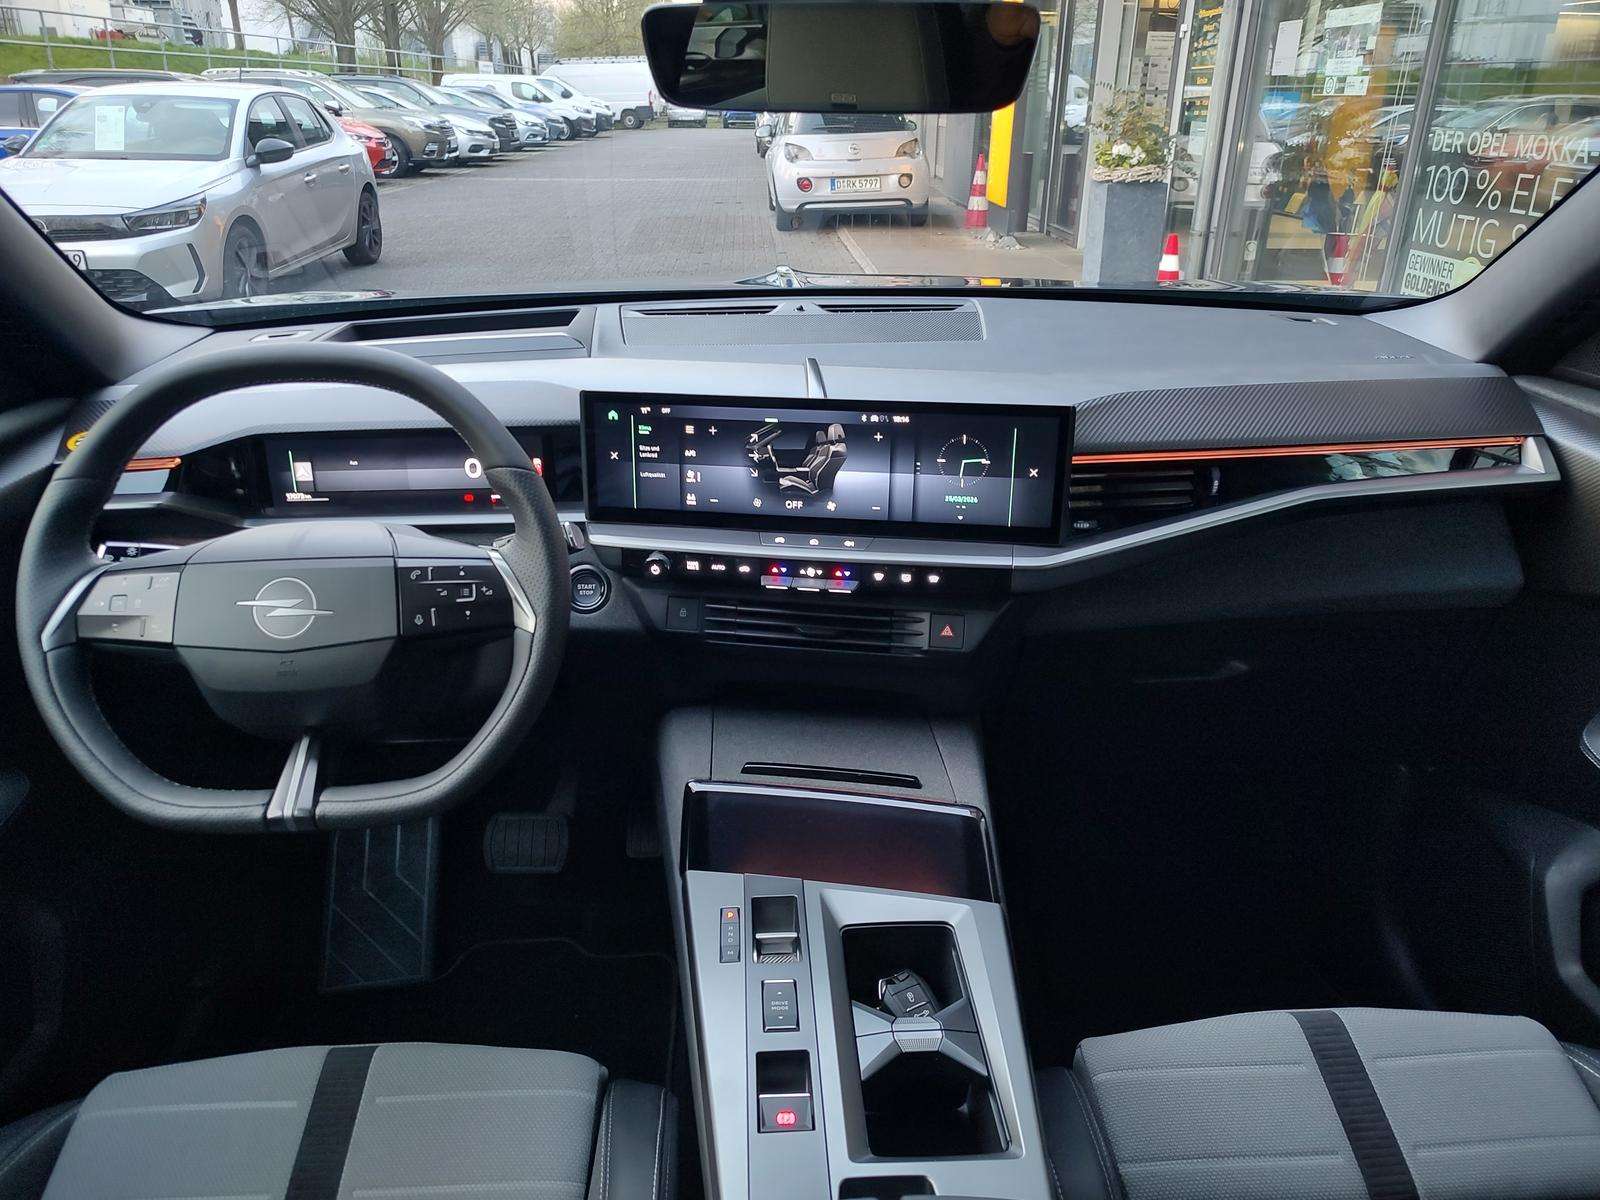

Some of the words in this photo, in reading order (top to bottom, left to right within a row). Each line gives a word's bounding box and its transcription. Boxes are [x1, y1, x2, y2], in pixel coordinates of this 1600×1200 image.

[1431, 129, 1464, 154] DER
[1466, 131, 1509, 157] OPEL
[858, 178, 879, 188] 5797
[1425, 165, 1469, 205] 100
[1475, 169, 1502, 211] %
[1509, 173, 1580, 217] ELE
[1412, 207, 1500, 259] MUTIG
[1408, 253, 1455, 281] GEWINNER
[785, 499, 804, 510] OFF
